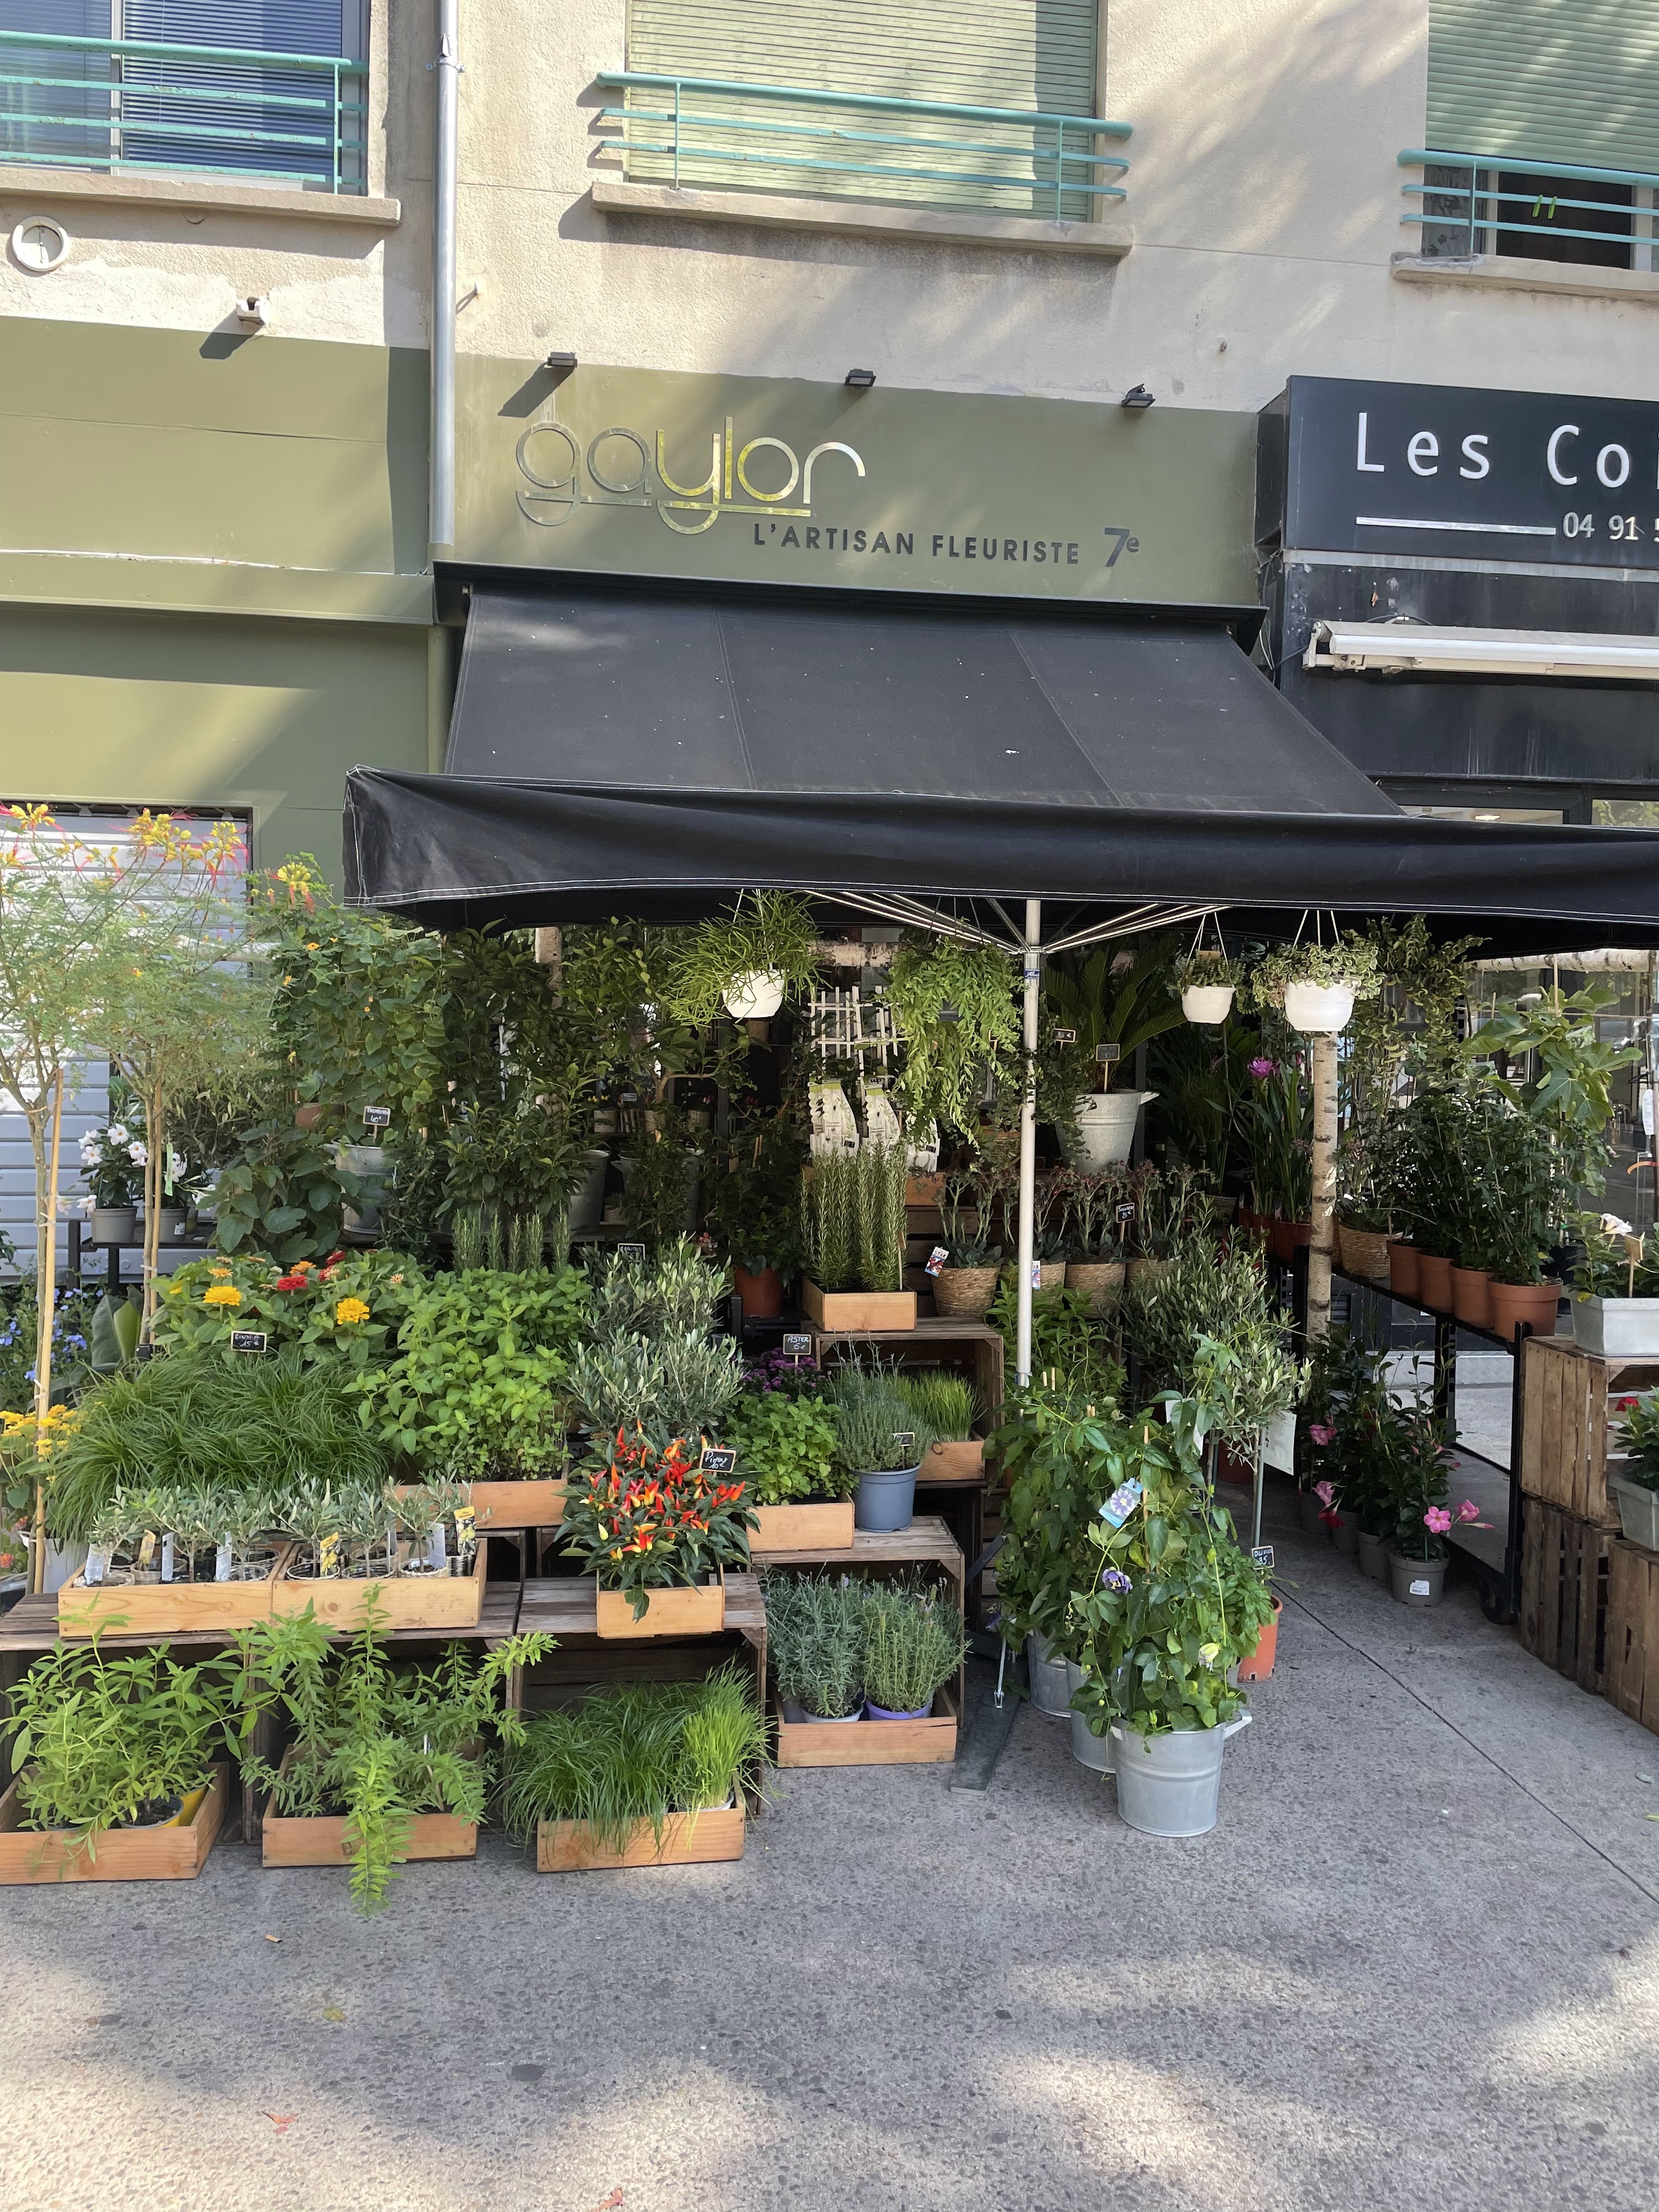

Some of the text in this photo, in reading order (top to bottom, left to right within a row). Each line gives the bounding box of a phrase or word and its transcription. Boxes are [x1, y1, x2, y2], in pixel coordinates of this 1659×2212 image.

[1356, 412, 1659, 490] Les Co
[516, 416, 866, 535] gaylor
[753, 523, 914, 555] L'ARTISAN
[932, 534, 1079, 565] FLEURISTE
[1563, 512, 1595, 538] 04
[1608, 515, 1639, 540] 91
[934, 1250, 946, 1259] STAR
